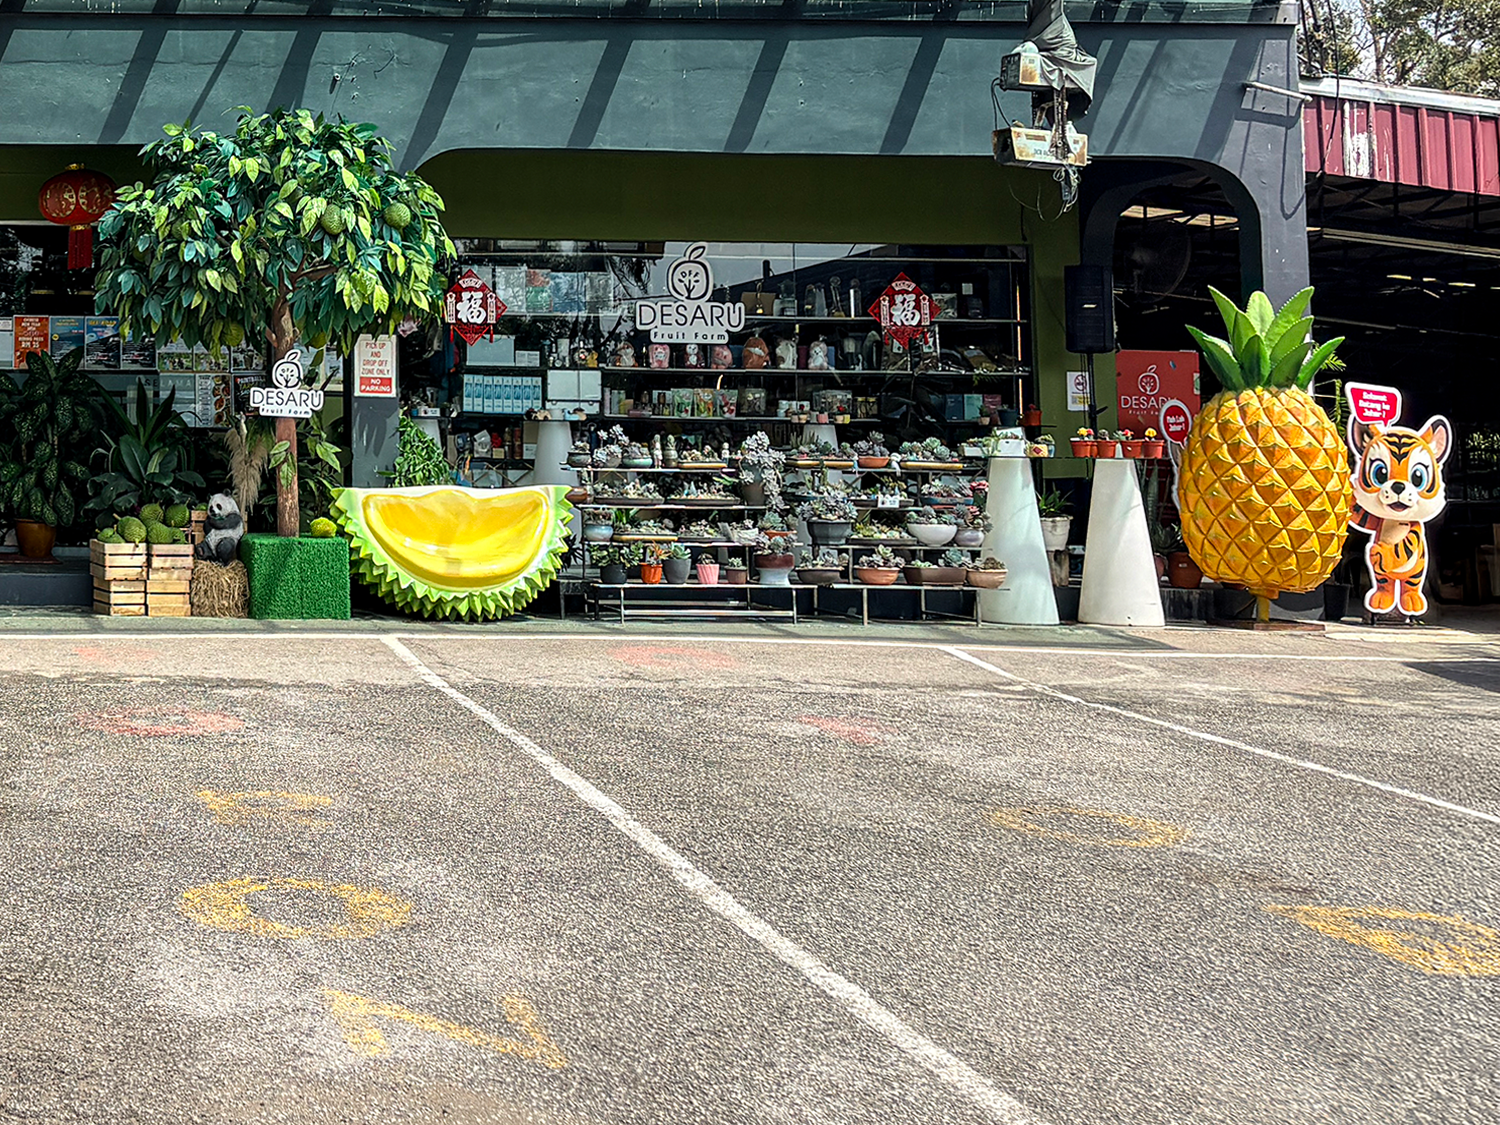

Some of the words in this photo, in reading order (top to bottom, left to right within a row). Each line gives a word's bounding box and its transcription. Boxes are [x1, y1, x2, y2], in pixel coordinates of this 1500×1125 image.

[456, 291, 486, 324] 福
[639, 304, 741, 328] DESARU
[891, 294, 921, 326] 福
[694, 332, 726, 340] Farm
[253, 390, 321, 408] DESARU
[1121, 395, 1173, 409] DESAR
